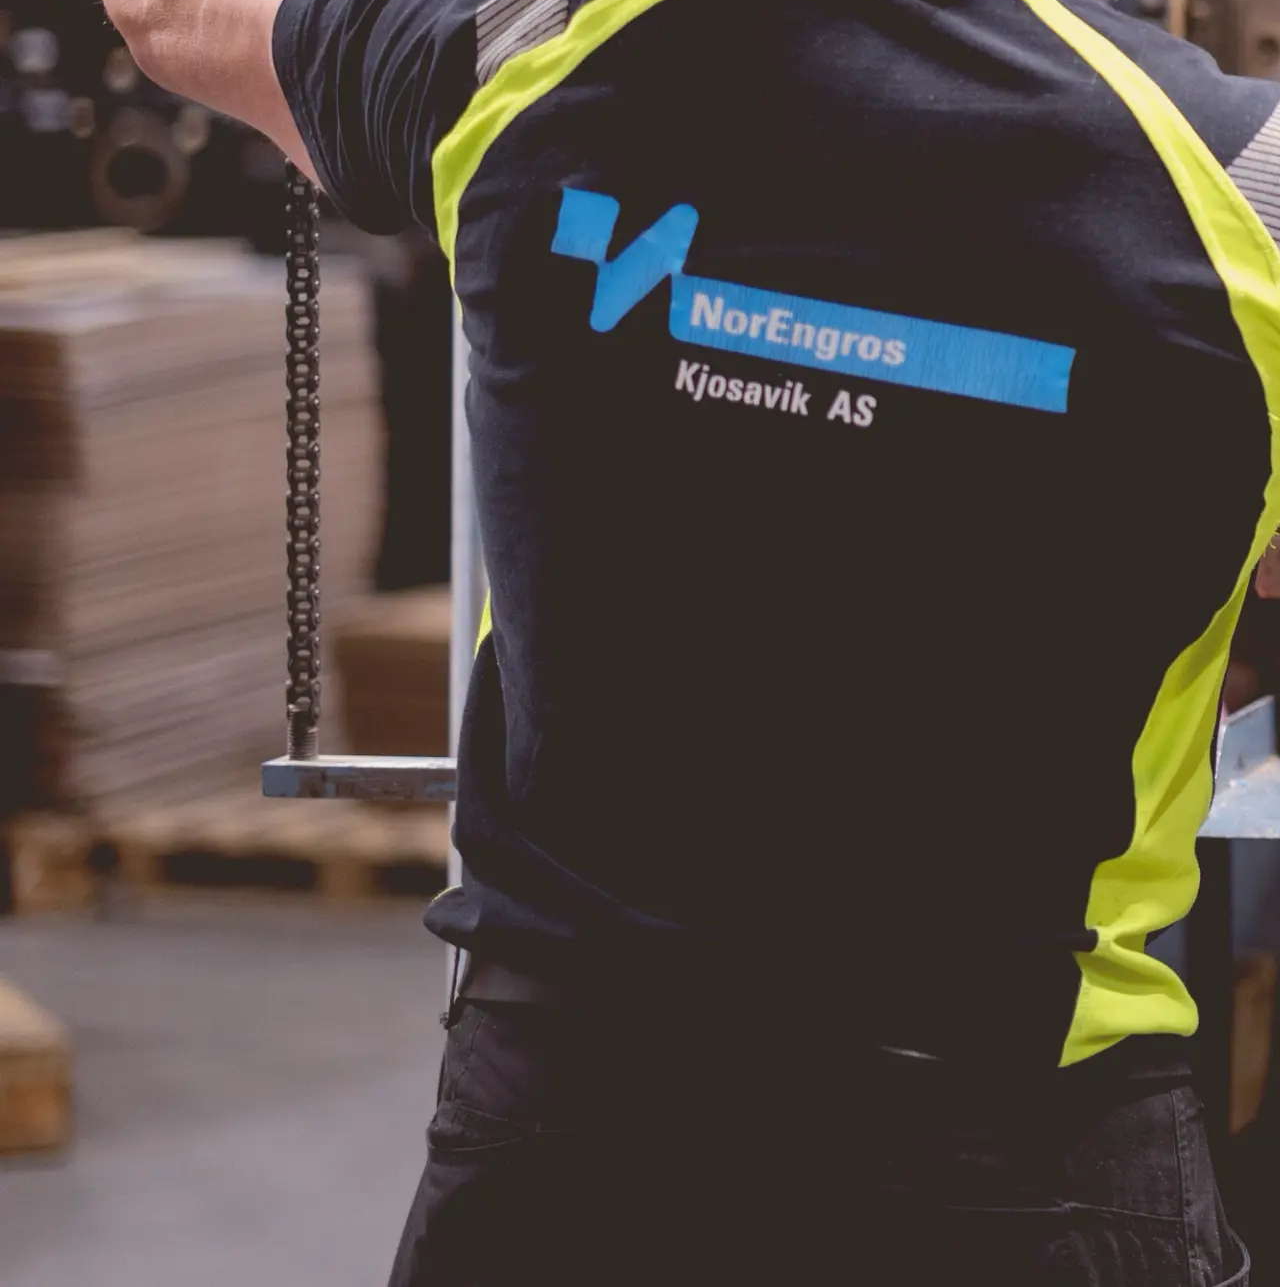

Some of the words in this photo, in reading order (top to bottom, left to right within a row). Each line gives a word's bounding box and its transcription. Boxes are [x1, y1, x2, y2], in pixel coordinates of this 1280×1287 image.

[690, 292, 906, 367] NorEngros
[674, 359, 810, 416] Kjosavik
[826, 390, 878, 427] AS
